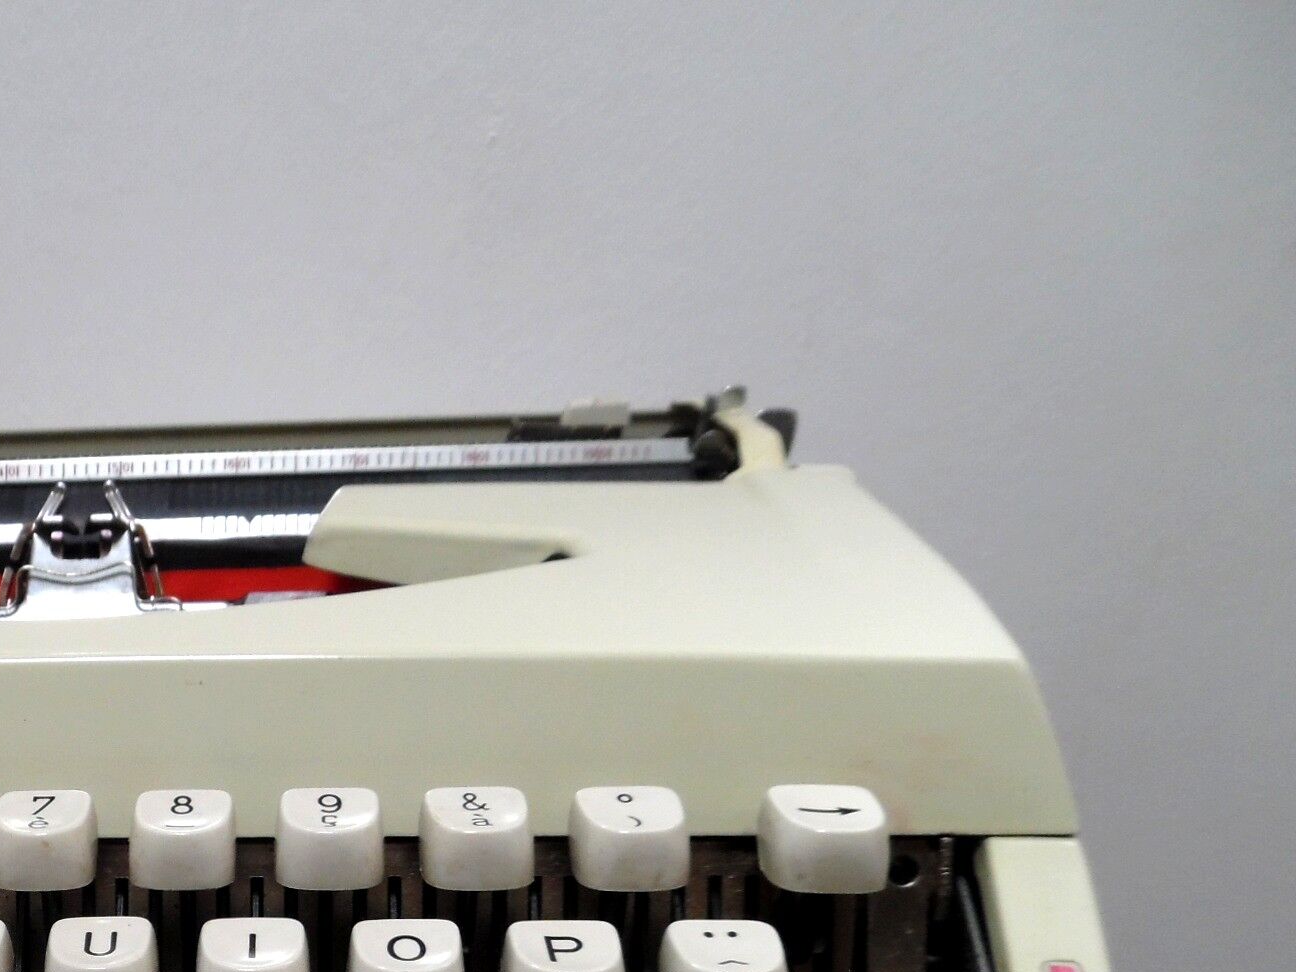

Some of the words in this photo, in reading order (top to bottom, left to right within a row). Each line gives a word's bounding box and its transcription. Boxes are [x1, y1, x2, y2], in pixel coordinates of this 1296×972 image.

[32, 795, 56, 816] 7
[170, 795, 194, 815] 8
[317, 793, 343, 814] 9
[462, 792, 489, 811] &
[27, 816, 49, 830] è
[83, 931, 118, 957] U
[248, 933, 257, 959] I
[386, 934, 427, 962] O
[543, 935, 583, 963] P
